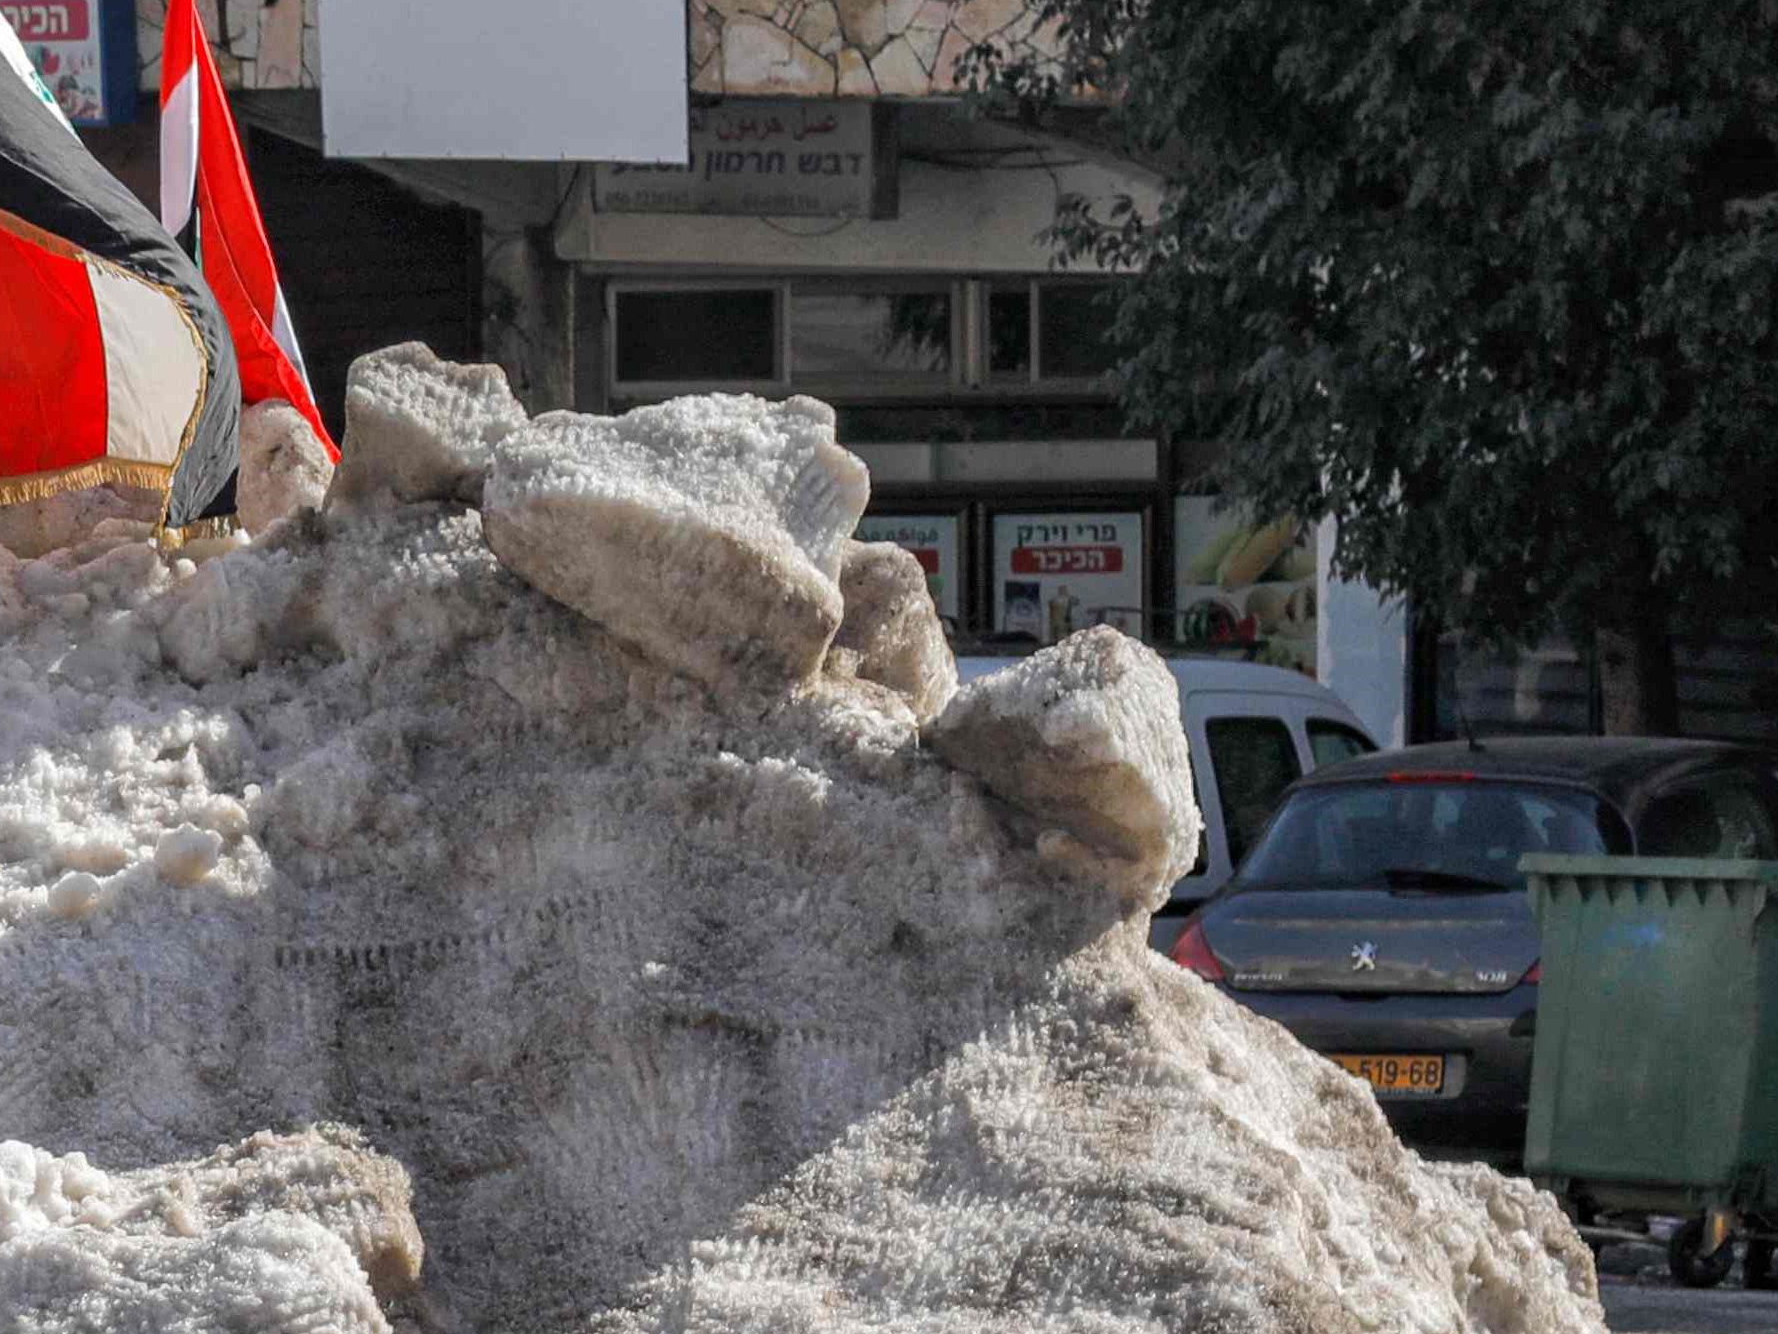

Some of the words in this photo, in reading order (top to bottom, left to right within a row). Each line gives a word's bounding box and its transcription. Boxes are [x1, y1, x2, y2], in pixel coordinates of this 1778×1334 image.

[704, 150, 785, 181] חרמון
[798, 151, 865, 175] דבש
[1016, 523, 1068, 547] וירק
[1076, 523, 1117, 542] פרי
[1031, 550, 1106, 570] הכיכר
